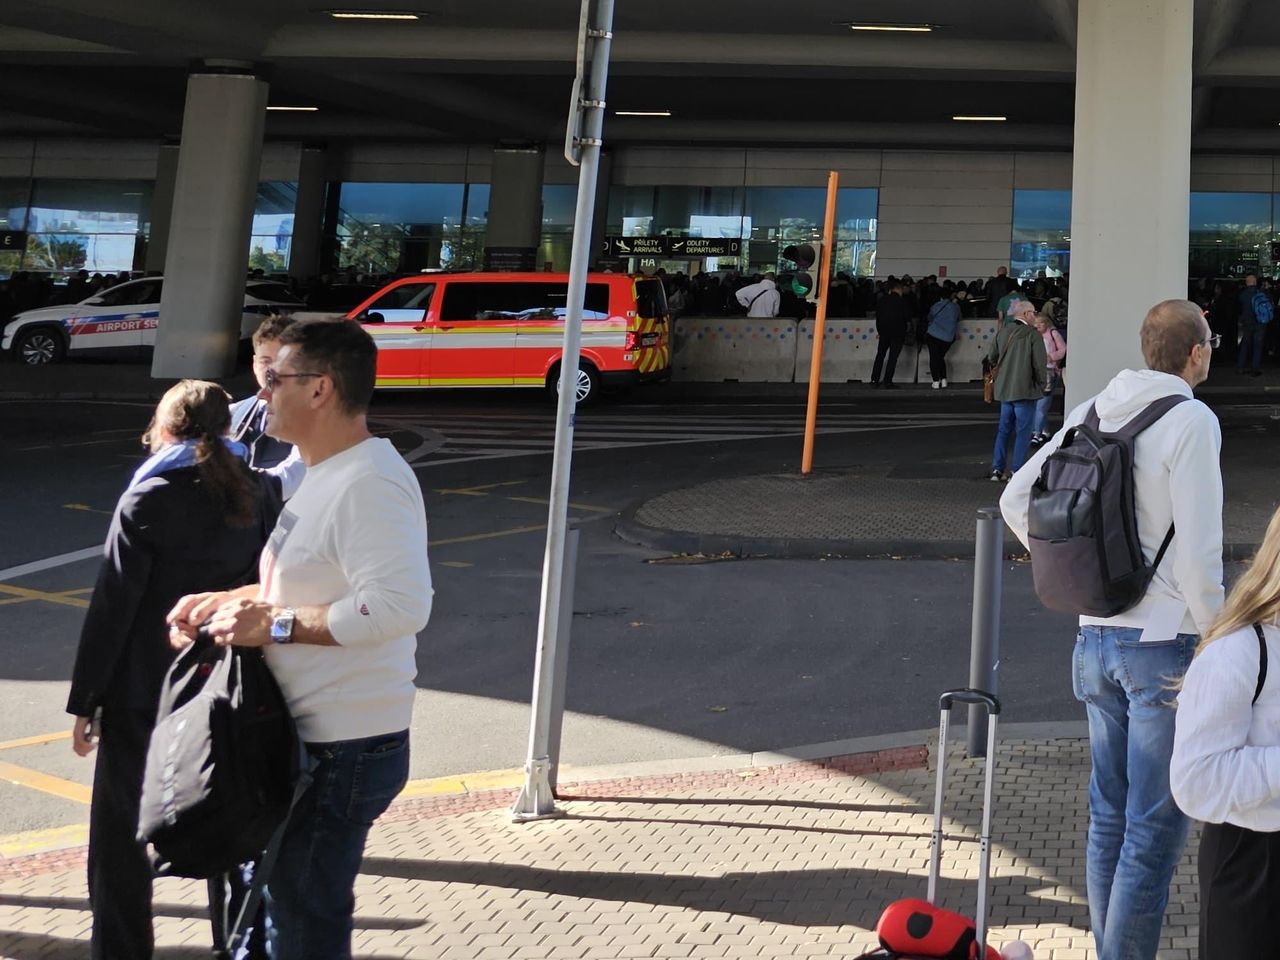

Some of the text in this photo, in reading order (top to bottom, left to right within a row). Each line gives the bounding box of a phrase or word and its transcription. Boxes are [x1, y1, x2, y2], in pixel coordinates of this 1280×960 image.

[633, 246, 662, 254] ARRIVALS
[686, 246, 724, 254] DEPARTURES
[731, 242, 738, 252] D
[96, 319, 159, 332] AIRPORT SE
